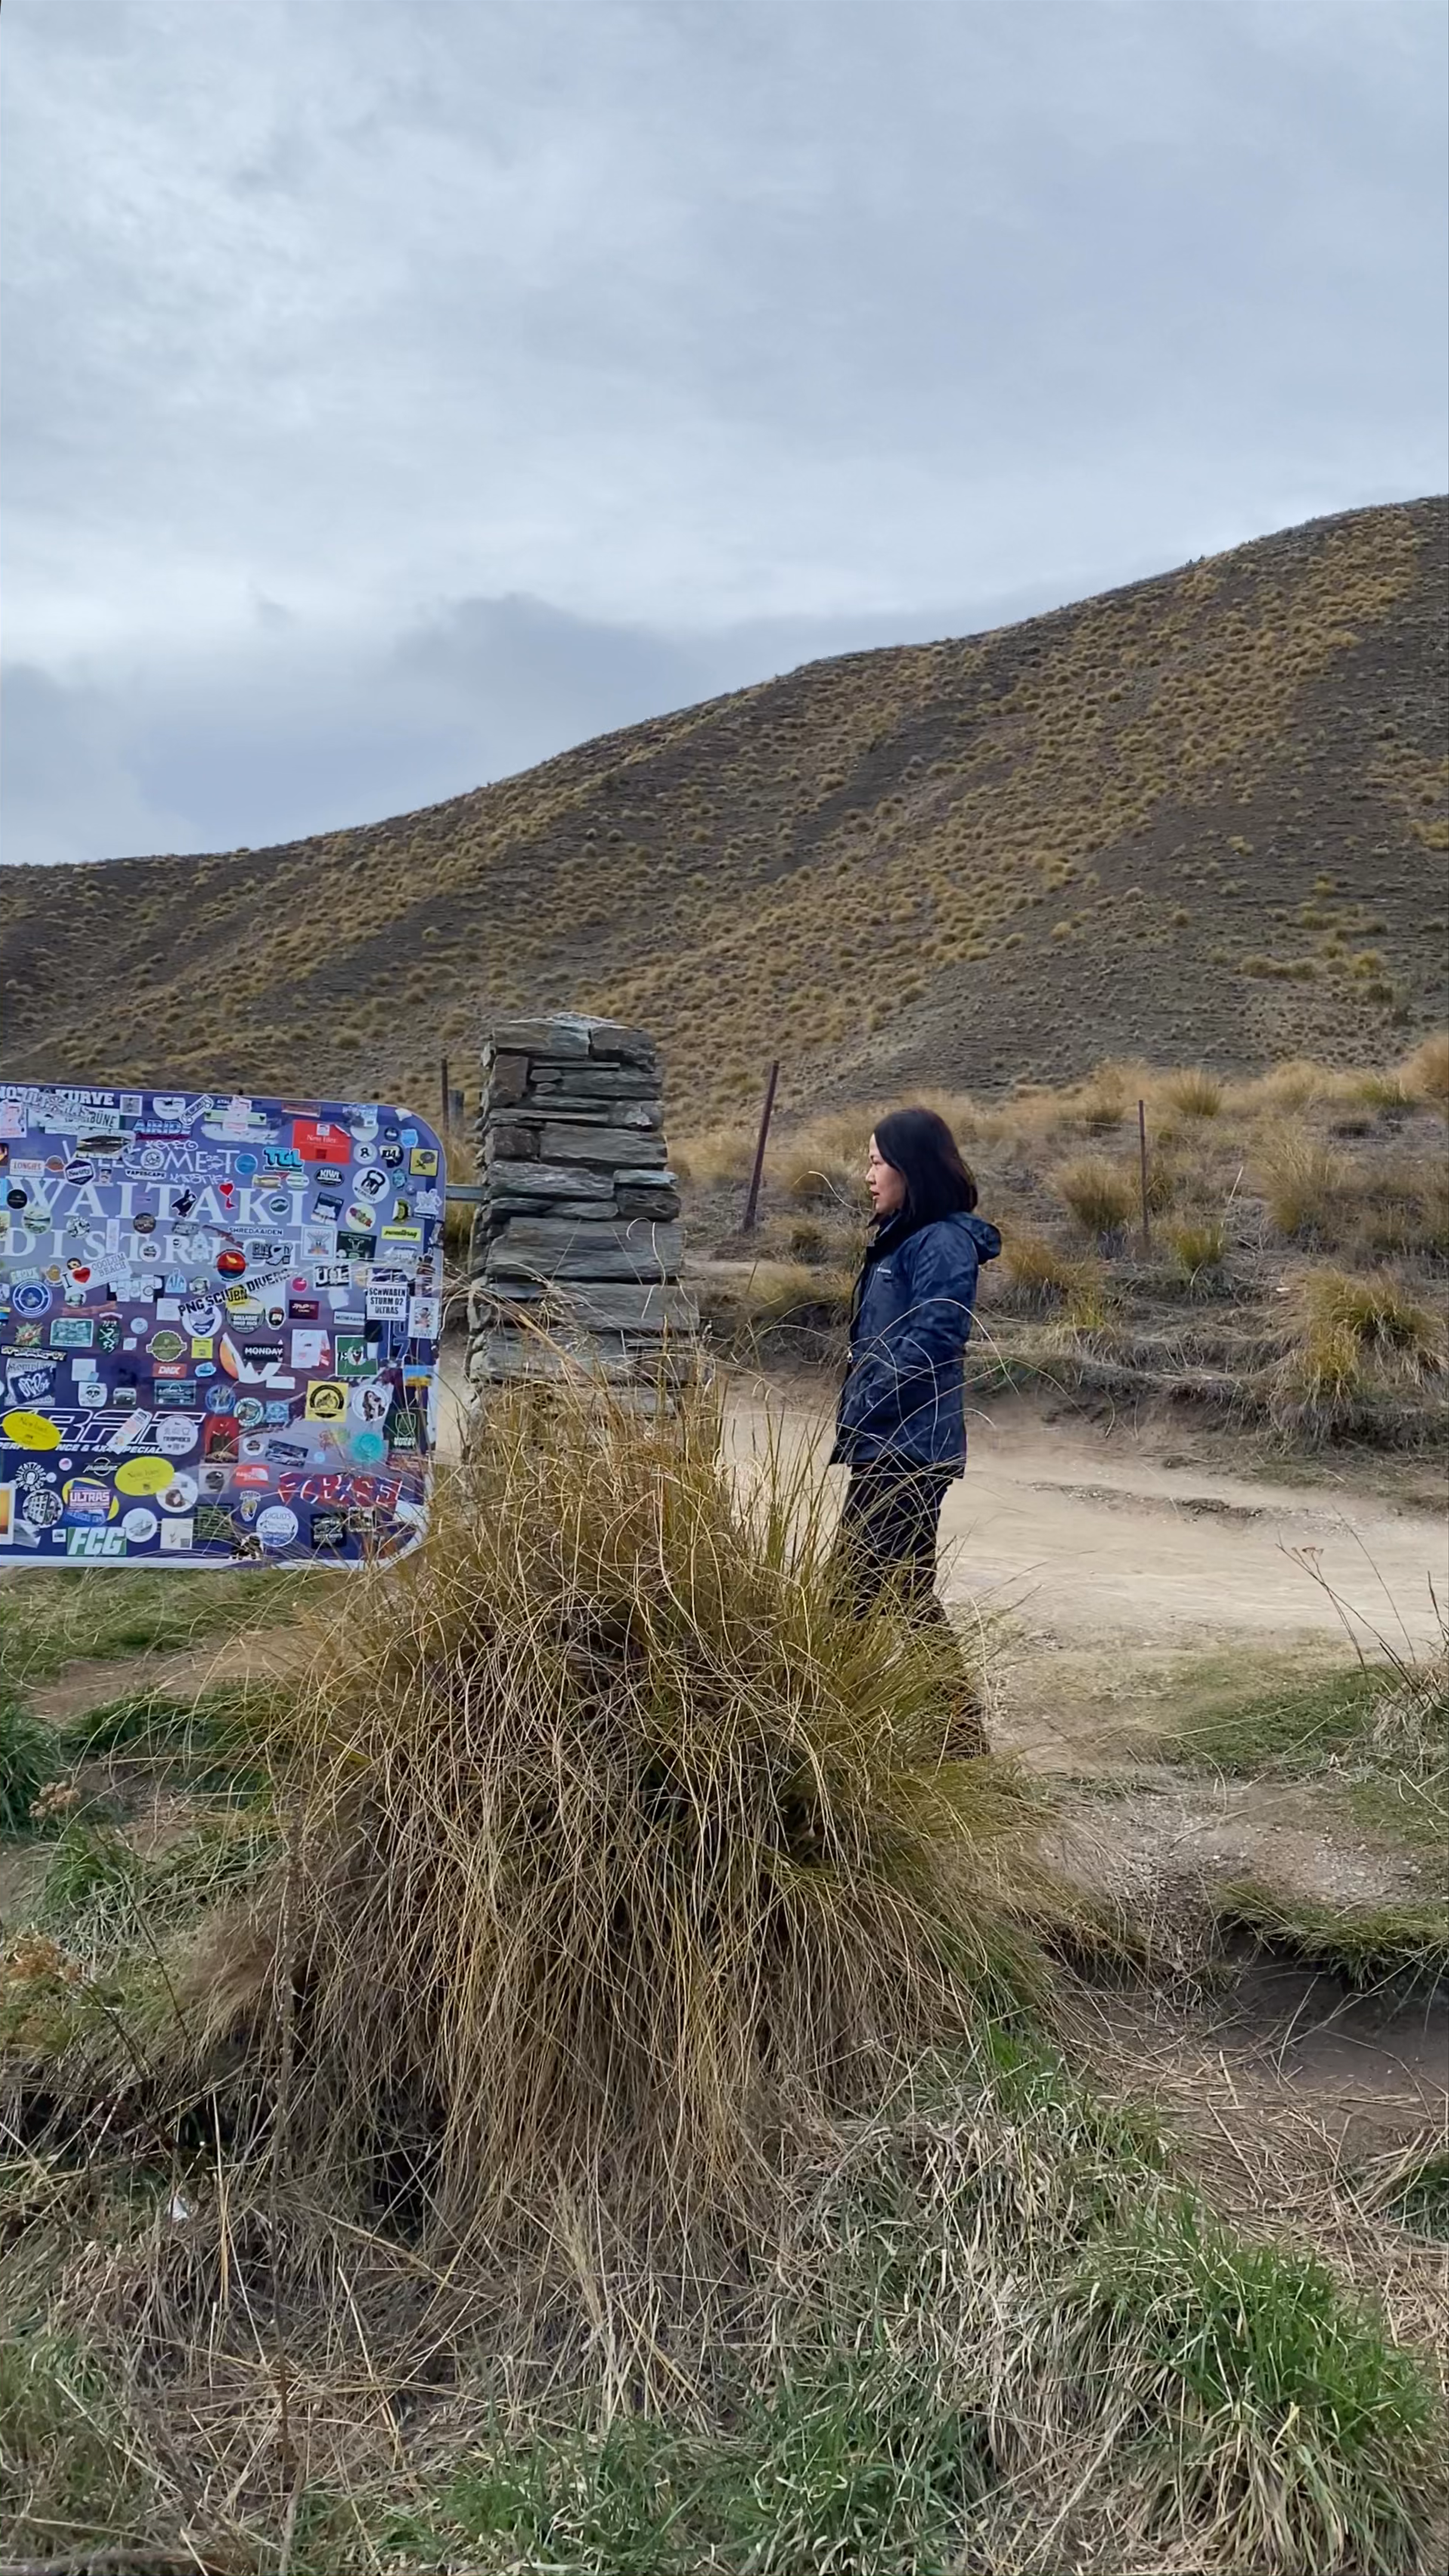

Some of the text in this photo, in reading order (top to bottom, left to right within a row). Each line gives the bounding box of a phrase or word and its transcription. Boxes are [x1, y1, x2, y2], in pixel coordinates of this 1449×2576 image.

[320, 1170, 340, 1178] KIWI
[5, 1176, 308, 1226] WAITAKI
[177, 1297, 205, 1316] PNG
[69, 1491, 110, 1502] ULTRAS
[68, 1527, 126, 1555] FCG
